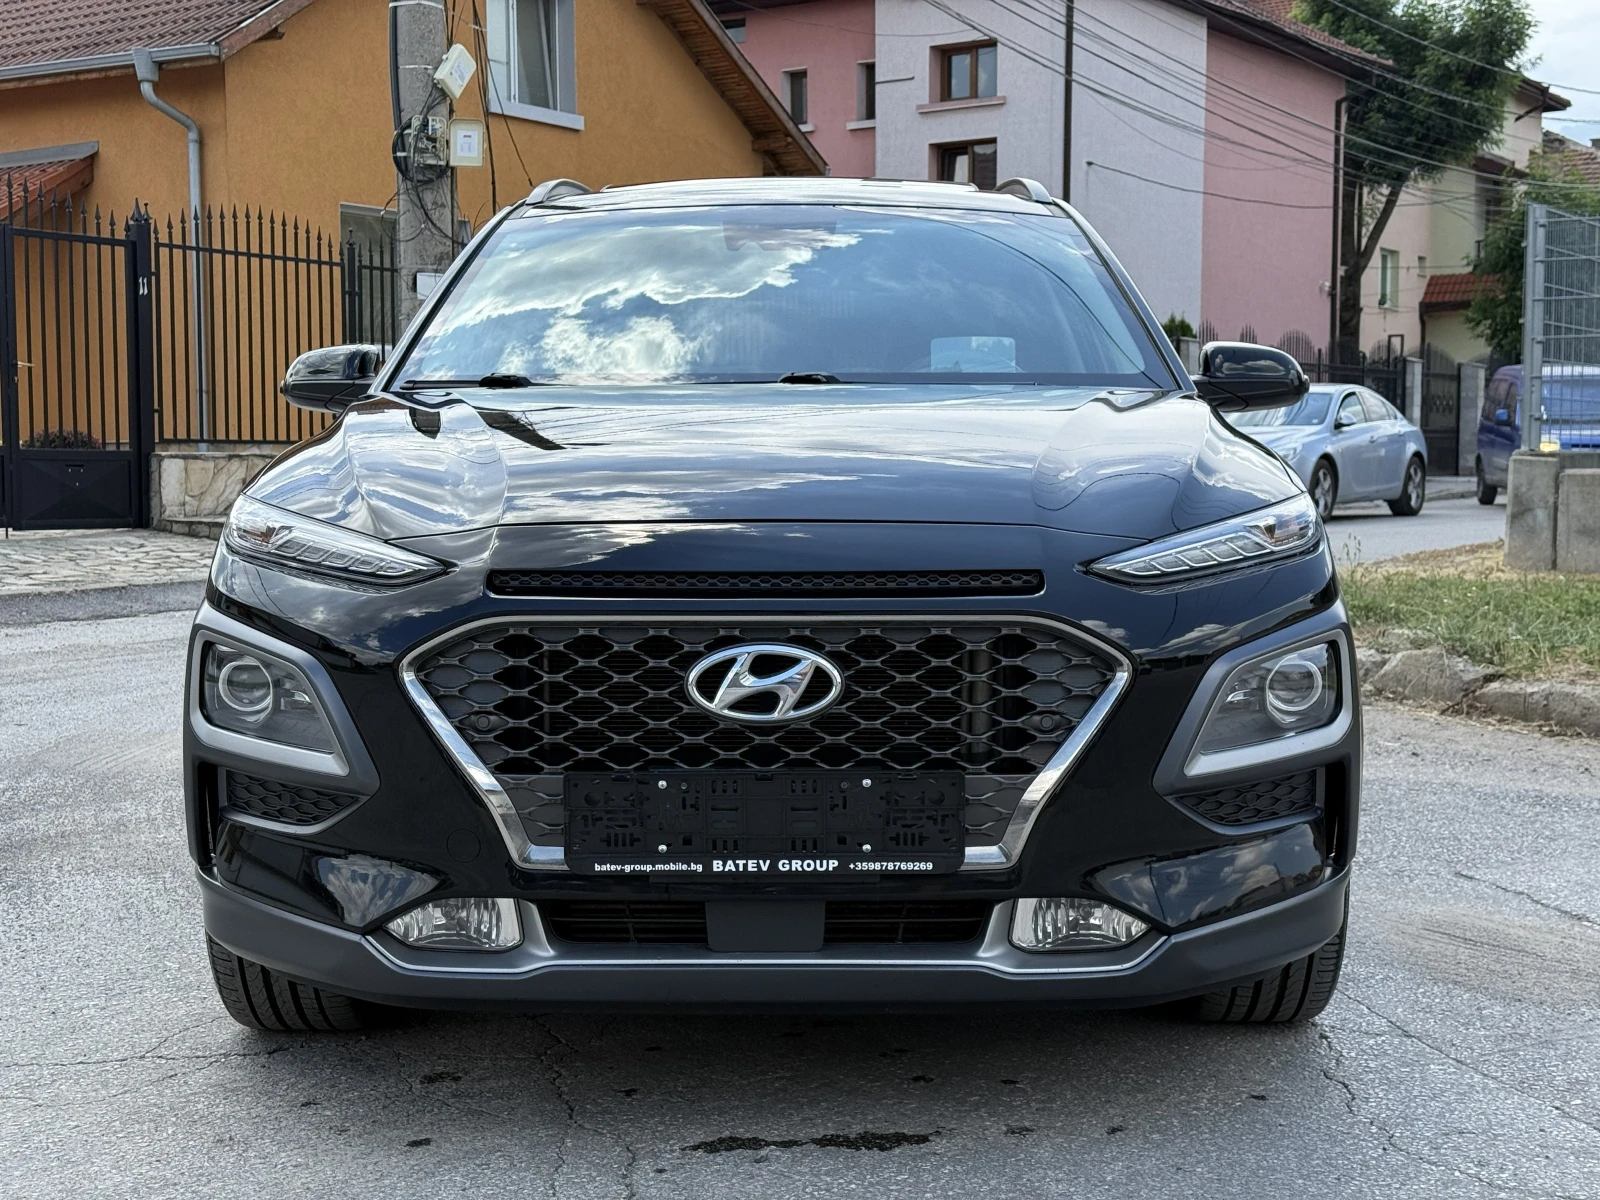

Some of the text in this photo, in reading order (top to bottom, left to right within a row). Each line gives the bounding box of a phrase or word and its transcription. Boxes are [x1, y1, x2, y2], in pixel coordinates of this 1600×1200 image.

[594, 859, 934, 873] batev-group.mobile.bg BATEV GROUP +359878769269
